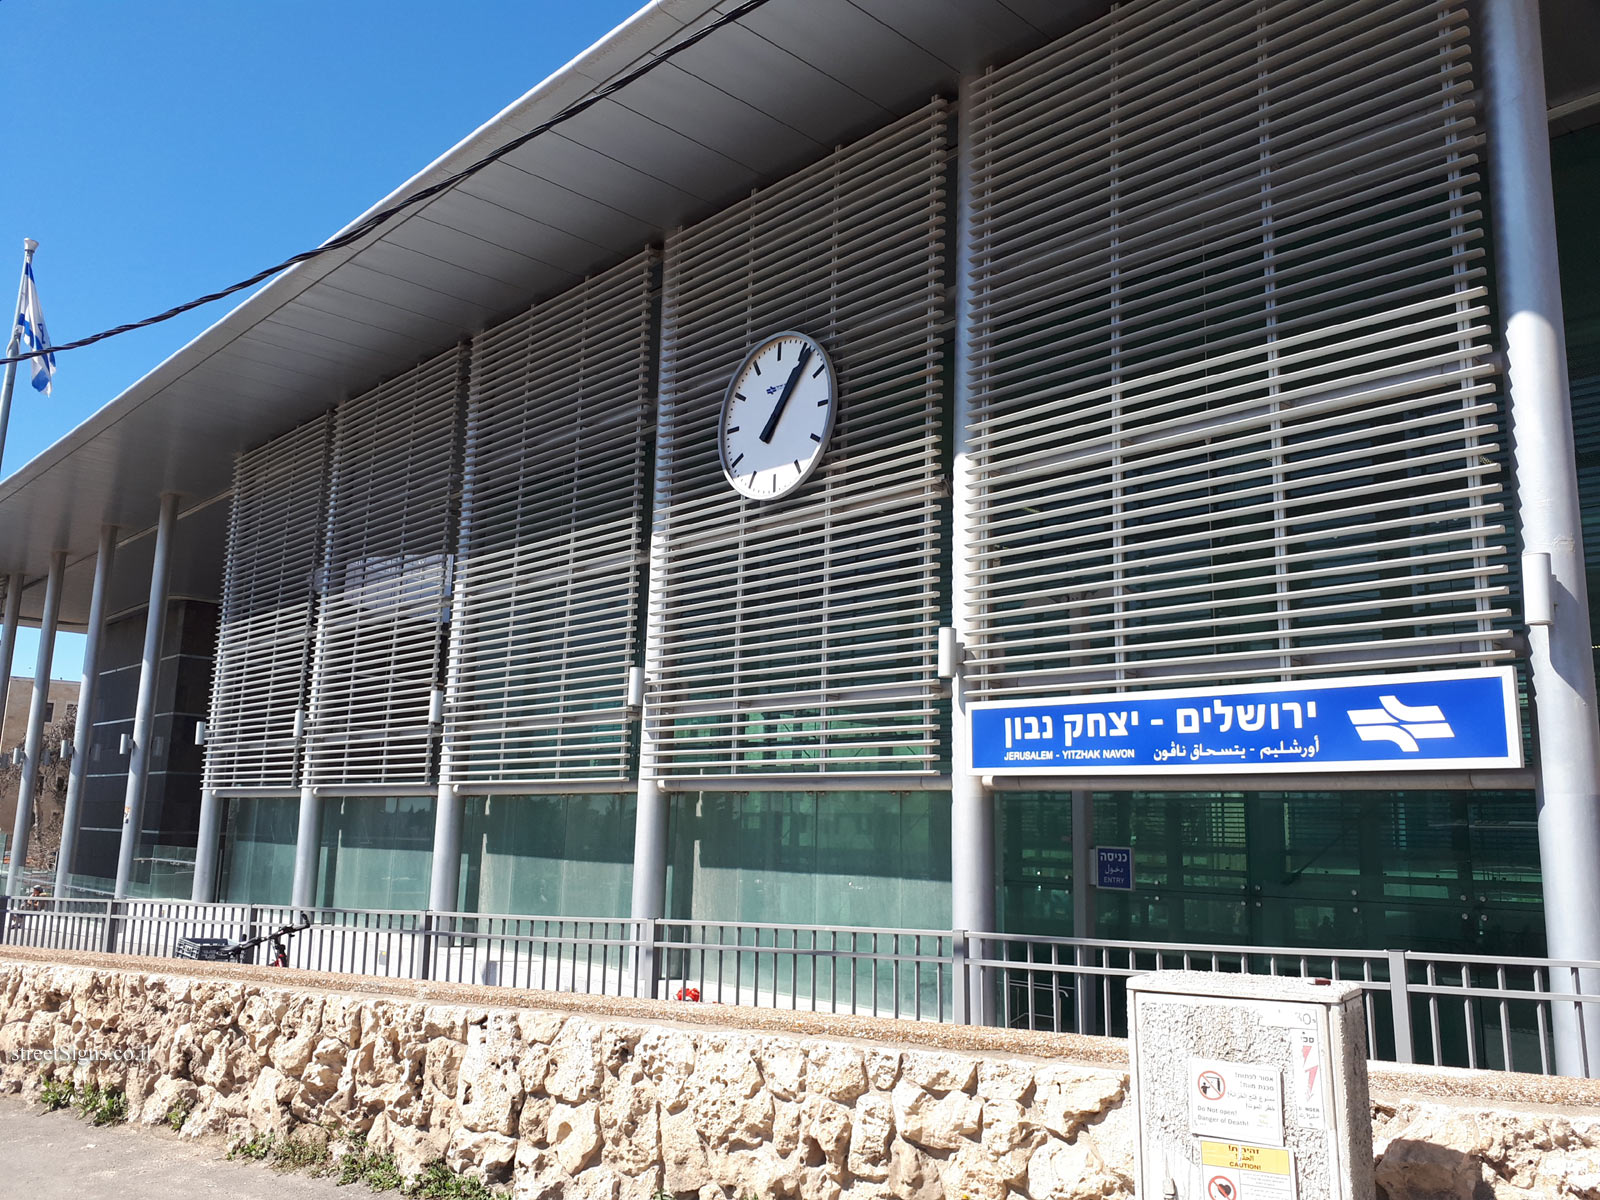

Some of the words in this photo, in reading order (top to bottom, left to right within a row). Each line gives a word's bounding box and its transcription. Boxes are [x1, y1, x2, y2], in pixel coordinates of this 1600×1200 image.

[1150, 718, 1164, 726] -
[1176, 699, 1317, 734] ירושלים
[1004, 715, 1053, 749] נבון
[1063, 710, 1139, 747] יצחק
[1004, 750, 1053, 761] JERUSALEM
[1062, 749, 1100, 760] YITZHAK
[1102, 748, 1135, 759] NAVON
[1190, 743, 1246, 760] يتسحاق
[1259, 735, 1320, 760] أورشليم
[1100, 852, 1128, 862] כניסה
[1206, 1106, 1218, 1114] Not
[1197, 1114, 1219, 1123] Danger
